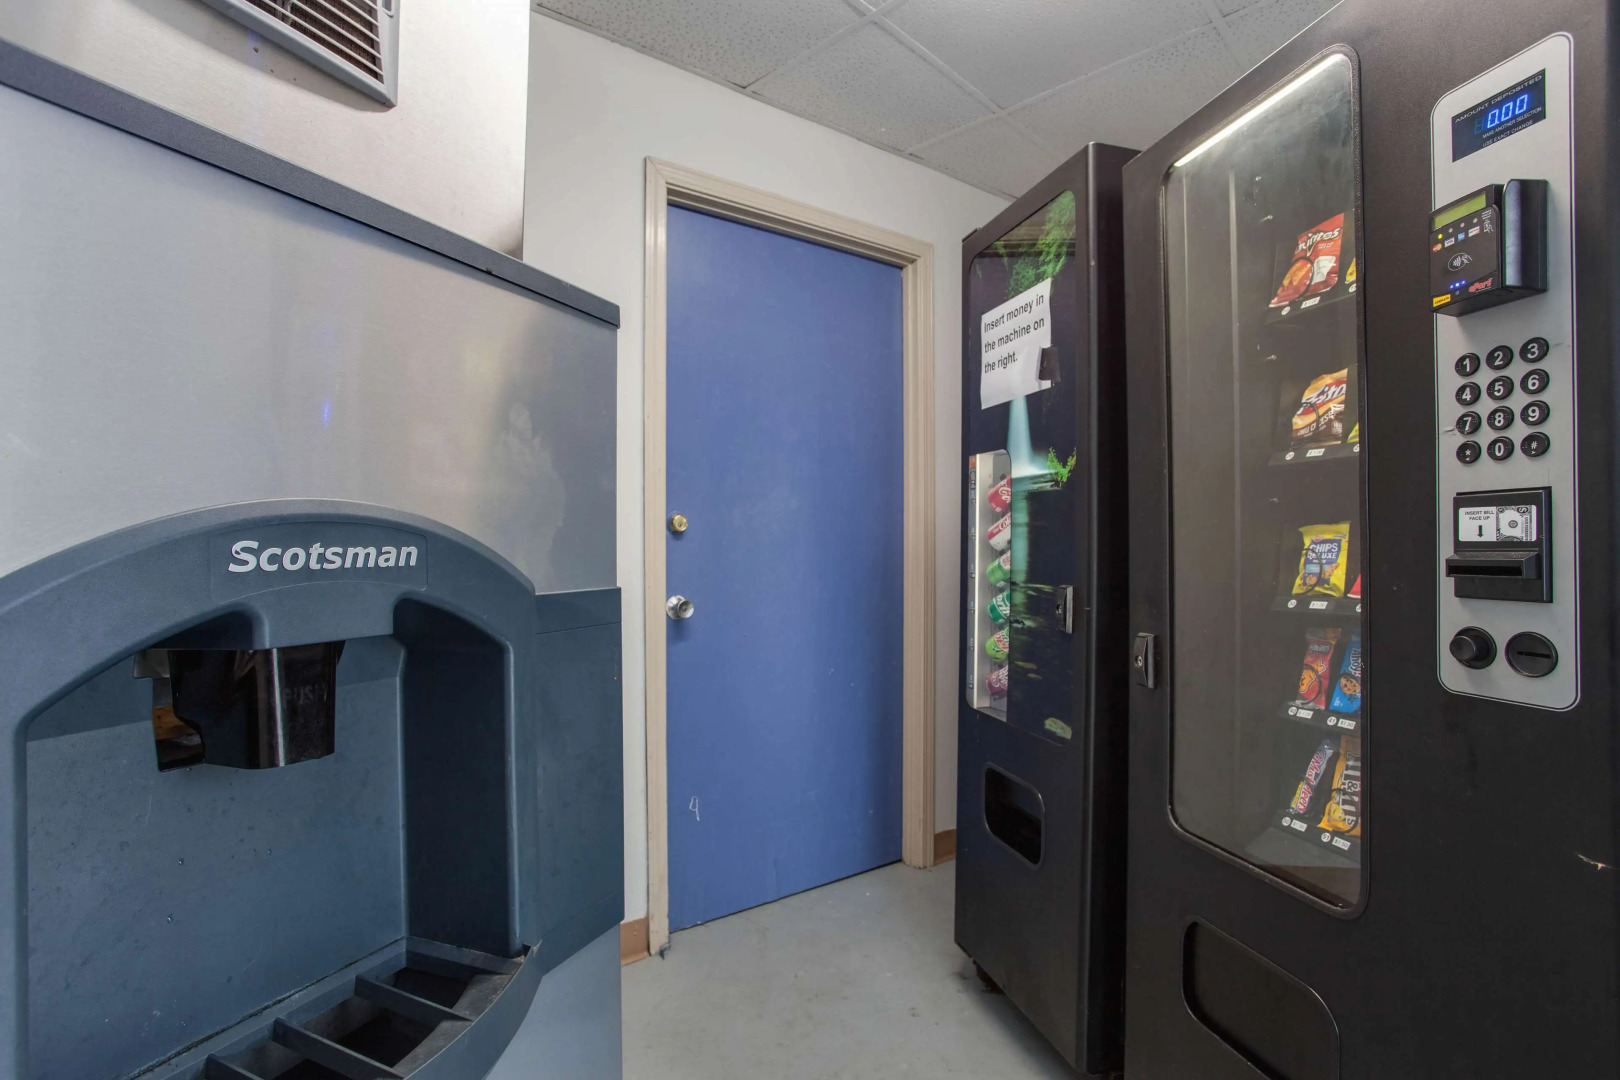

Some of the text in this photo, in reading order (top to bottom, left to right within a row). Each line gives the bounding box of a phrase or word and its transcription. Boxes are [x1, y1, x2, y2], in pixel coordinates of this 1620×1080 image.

[1455, 75, 1542, 123] AMOUNT DEPOSITED
[1494, 132, 1510, 142] EXACT
[1511, 120, 1533, 134] CHANGE
[1495, 120, 1516, 133] ANOTHER
[1516, 106, 1542, 123] SELECTION
[984, 293, 1044, 333] Insert money in
[984, 317, 1044, 353] the machine on
[984, 351, 1018, 374] the right.
[1463, 343, 1538, 371] 1 2 3
[1462, 375, 1539, 401] 4 5 6
[1463, 406, 1539, 431] 7 8 9
[1495, 443, 1504, 456] 0
[228, 540, 418, 573] Scotsman
[1309, 542, 1338, 552] CHIPS
